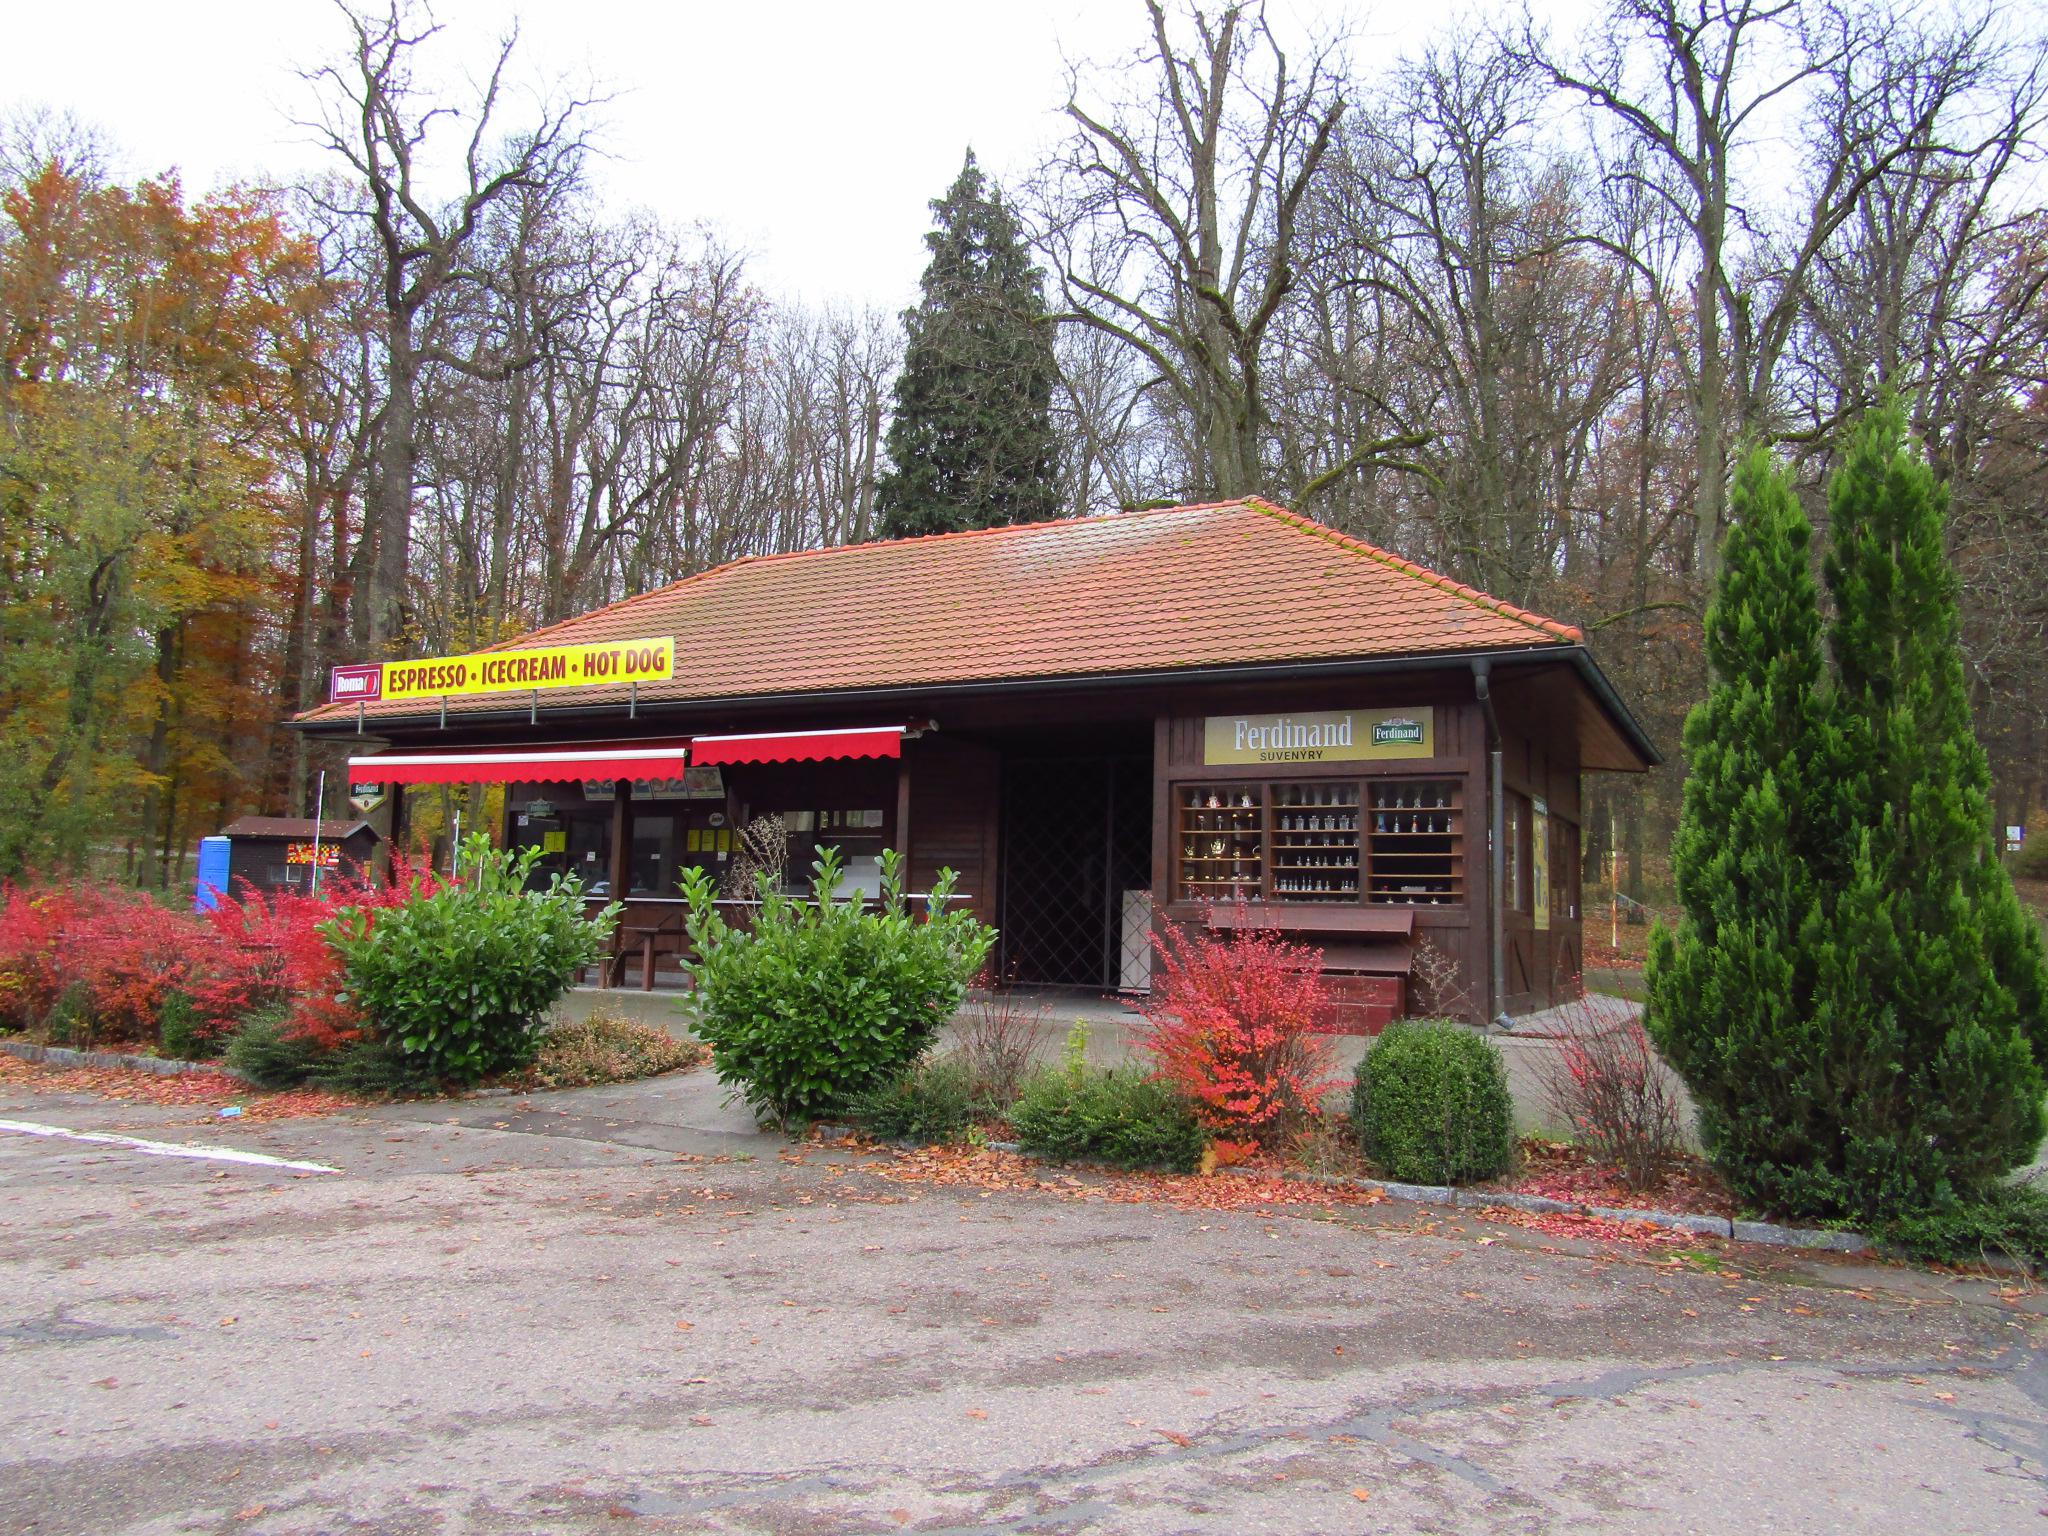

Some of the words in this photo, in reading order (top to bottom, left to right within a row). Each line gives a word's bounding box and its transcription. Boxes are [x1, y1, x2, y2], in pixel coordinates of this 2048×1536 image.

[389, 664, 467, 692] ESPRESSO
[482, 655, 566, 685] ICECREAM
[583, 651, 621, 677] HOT
[625, 647, 665, 673] DOG
[337, 676, 364, 692] Roma
[1234, 715, 1353, 750] Ferdinand
[1376, 726, 1419, 739] Ferdinand
[1259, 749, 1323, 761] SUVENÝRY
